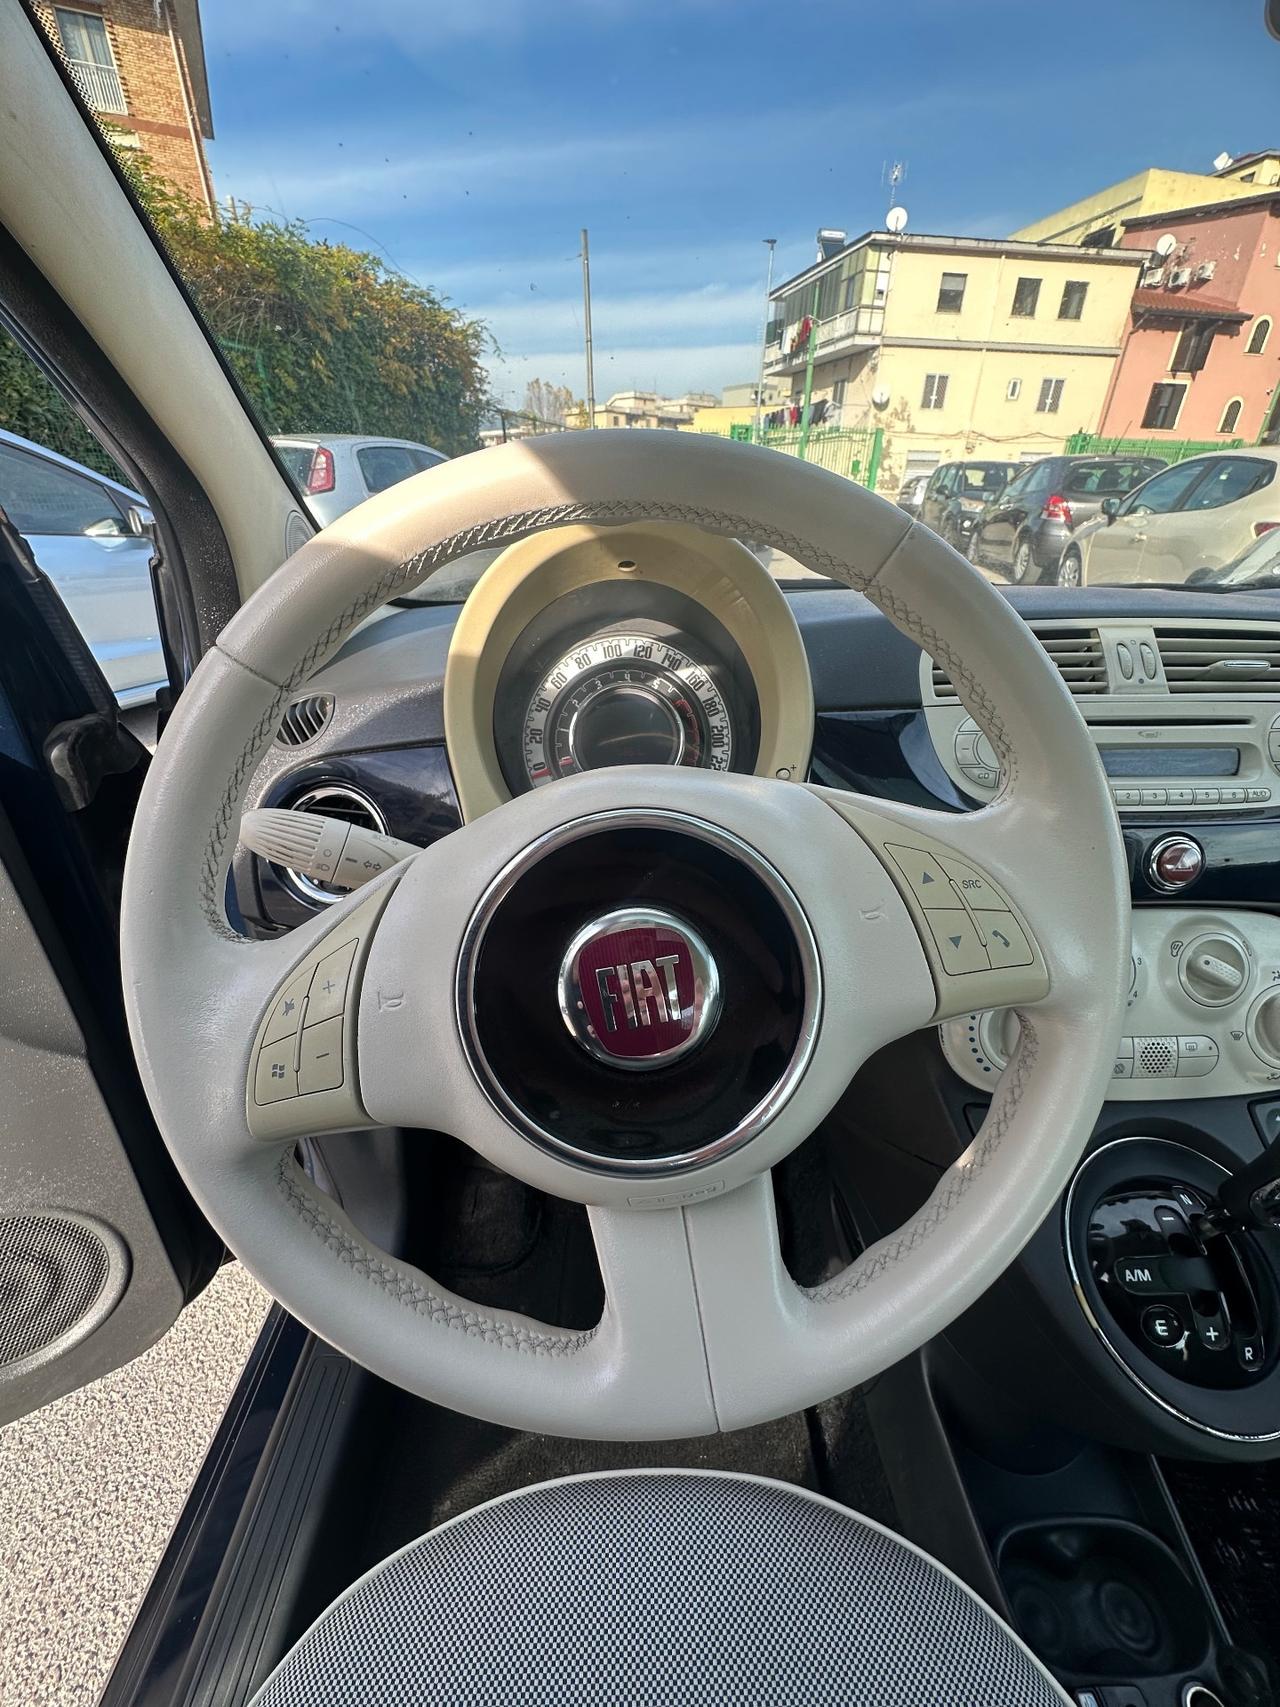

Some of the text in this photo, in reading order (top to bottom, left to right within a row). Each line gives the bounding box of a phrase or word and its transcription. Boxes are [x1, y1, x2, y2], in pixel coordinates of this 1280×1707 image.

[603, 644, 622, 659] 100
[633, 644, 653, 659] 120
[574, 653, 592, 670] 80
[661, 652, 682, 671] 140
[550, 671, 568, 690] 60
[595, 680, 603, 690] 3
[624, 673, 632, 683] 4
[651, 680, 661, 690] 5
[684, 671, 705, 692] 160
[534, 697, 551, 713] 40
[702, 696, 720, 718] 180
[529, 728, 543, 744] 20
[711, 724, 725, 748] 200
[532, 761, 546, 771] 0
[711, 754, 724, 771] 22
[978, 772, 990, 780] CD
[962, 879, 982, 889] SRC
[1136, 956, 1142, 966] 3
[595, 954, 682, 1032] FIAT
[1179, 1193, 1193, 1205] N
[1125, 1268, 1152, 1282] A/M
[1155, 1319, 1169, 1336] E
[1244, 1347, 1254, 1360] R
